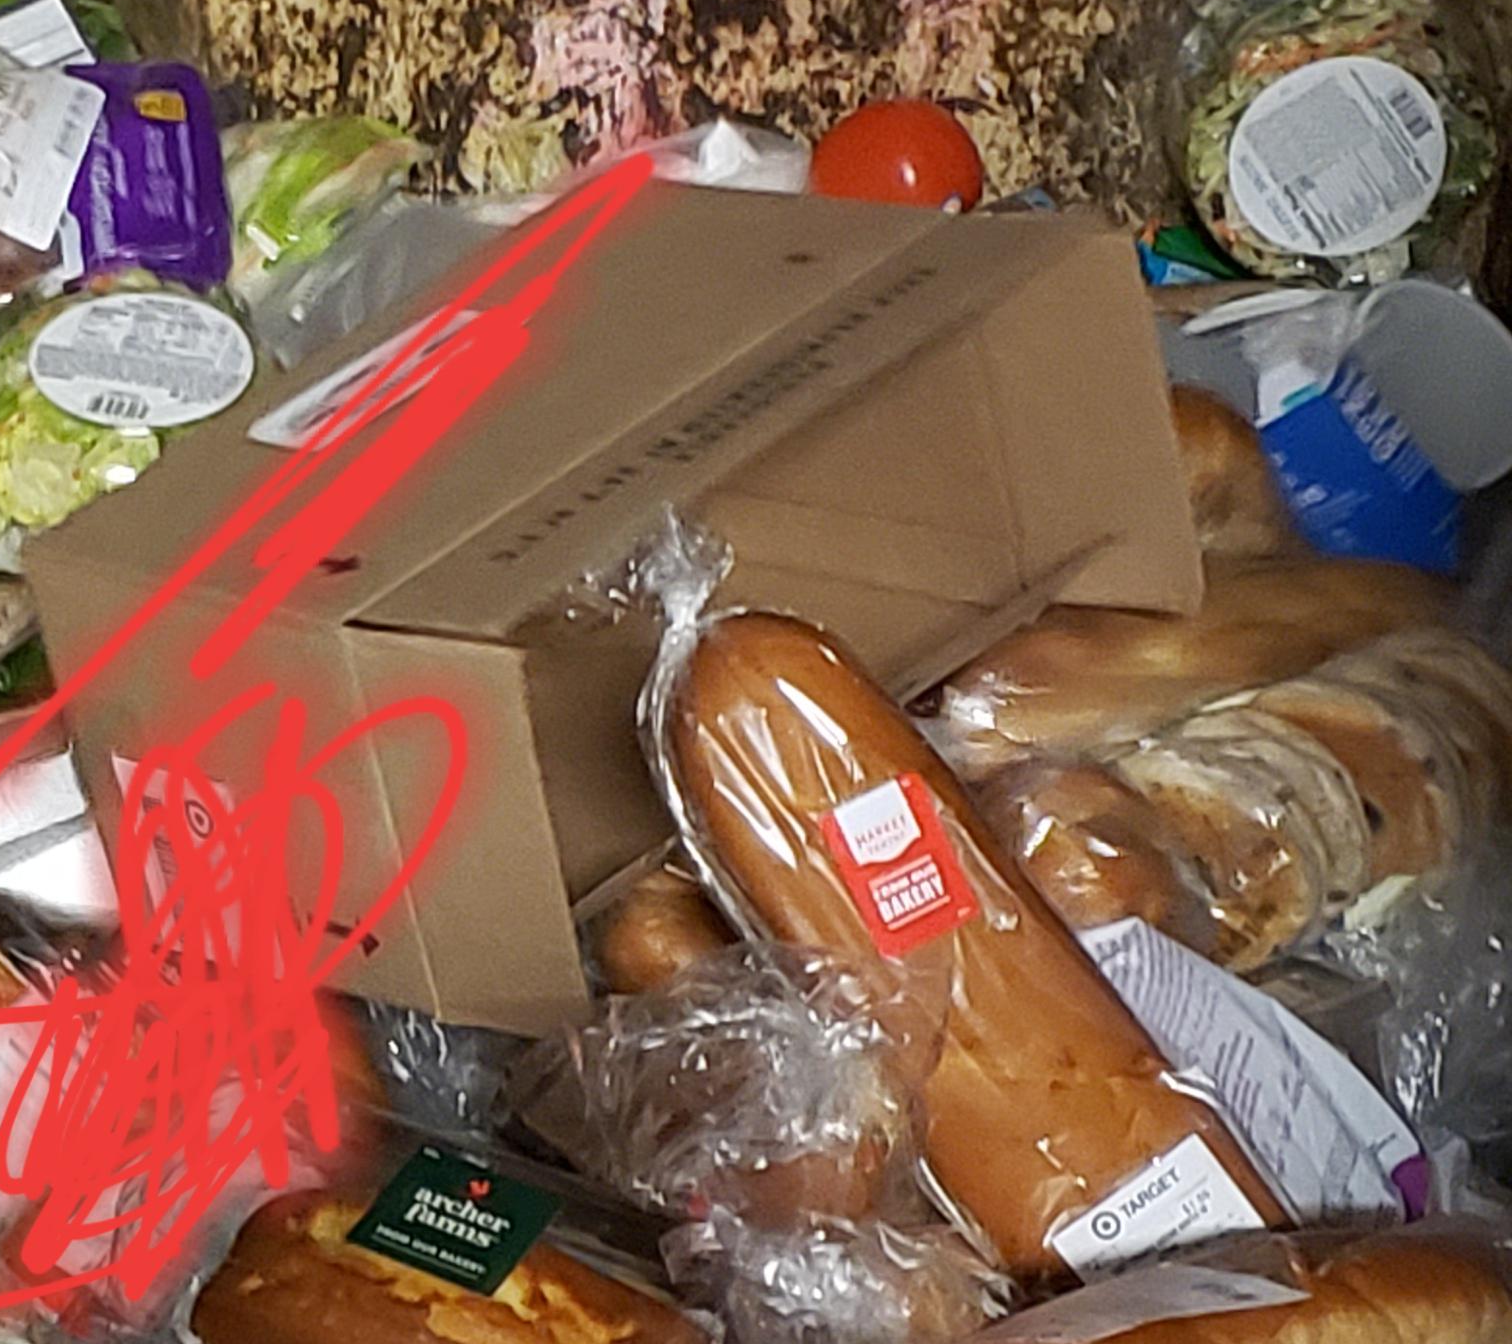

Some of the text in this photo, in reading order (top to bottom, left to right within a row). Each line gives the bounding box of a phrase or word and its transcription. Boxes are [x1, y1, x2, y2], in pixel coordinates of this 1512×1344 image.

[877, 874, 946, 923] BAKERY
[414, 1186, 511, 1234] archer
[1120, 1166, 1181, 1220] TARGET
[403, 1202, 495, 1248] farms
